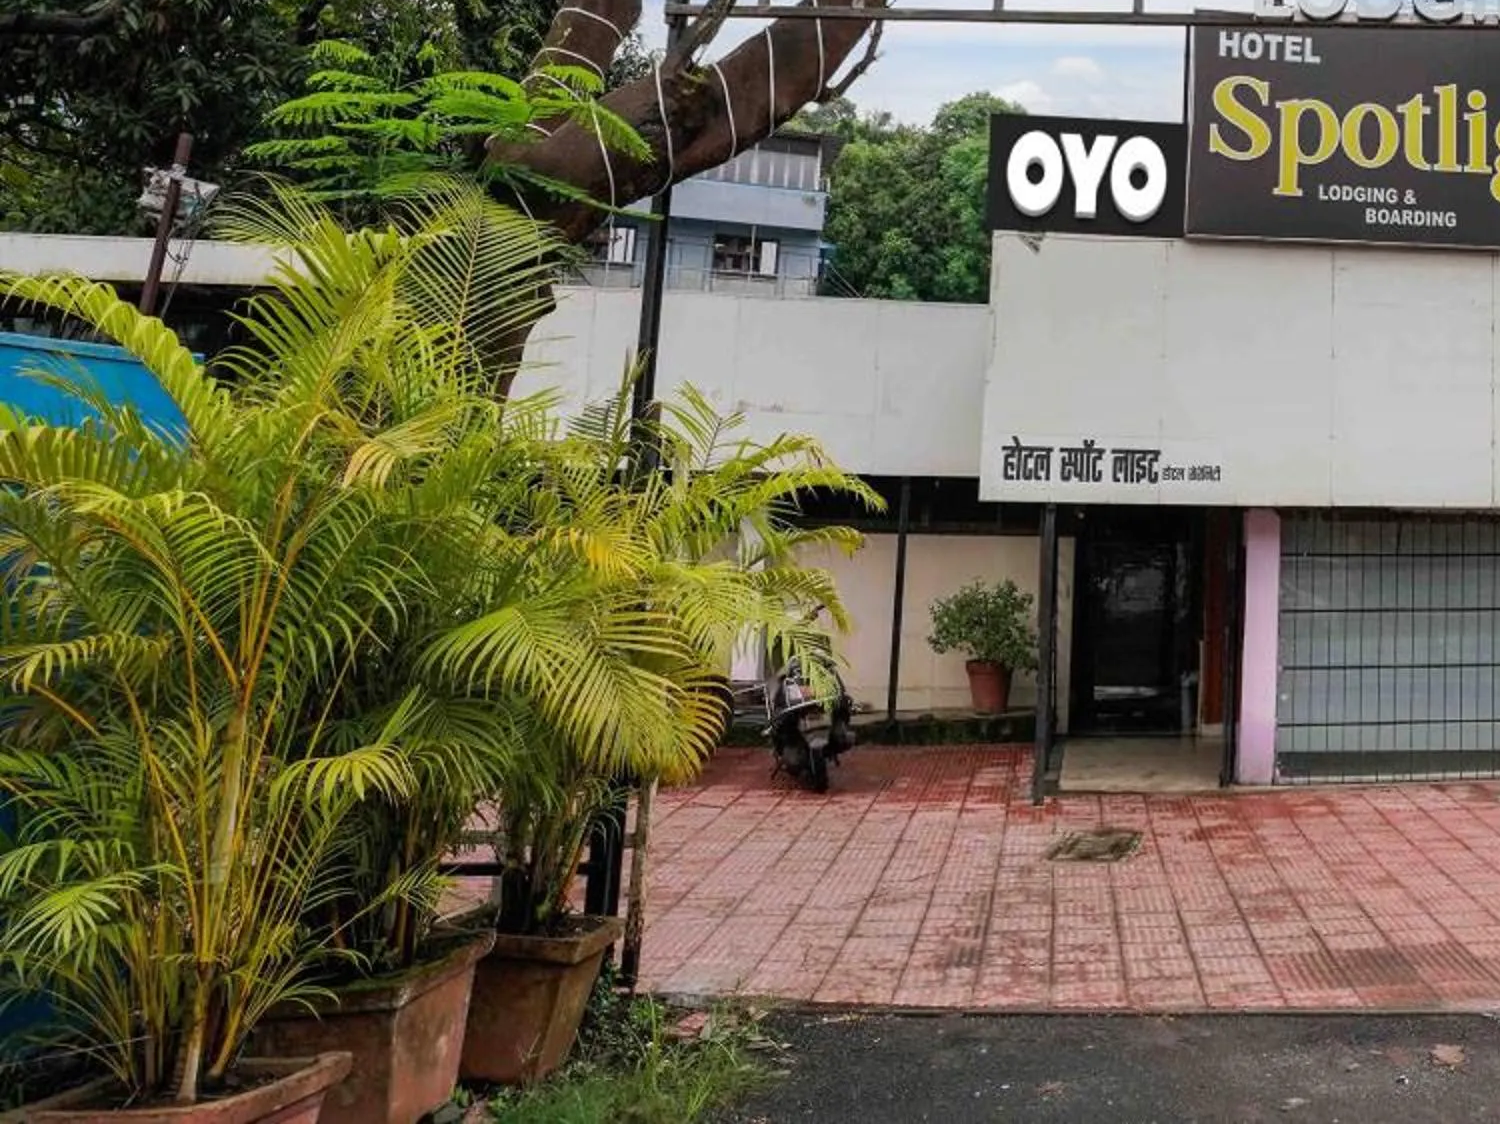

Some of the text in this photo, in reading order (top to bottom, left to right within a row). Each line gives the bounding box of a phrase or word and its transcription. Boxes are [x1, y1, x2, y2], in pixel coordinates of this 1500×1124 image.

[1218, 30, 1321, 64] HOTEL
[1006, 129, 1168, 223] OYO
[1318, 184, 1417, 205] LODGING &
[1365, 207, 1457, 227] BOARDING
[1002, 435, 1054, 482] होटल
